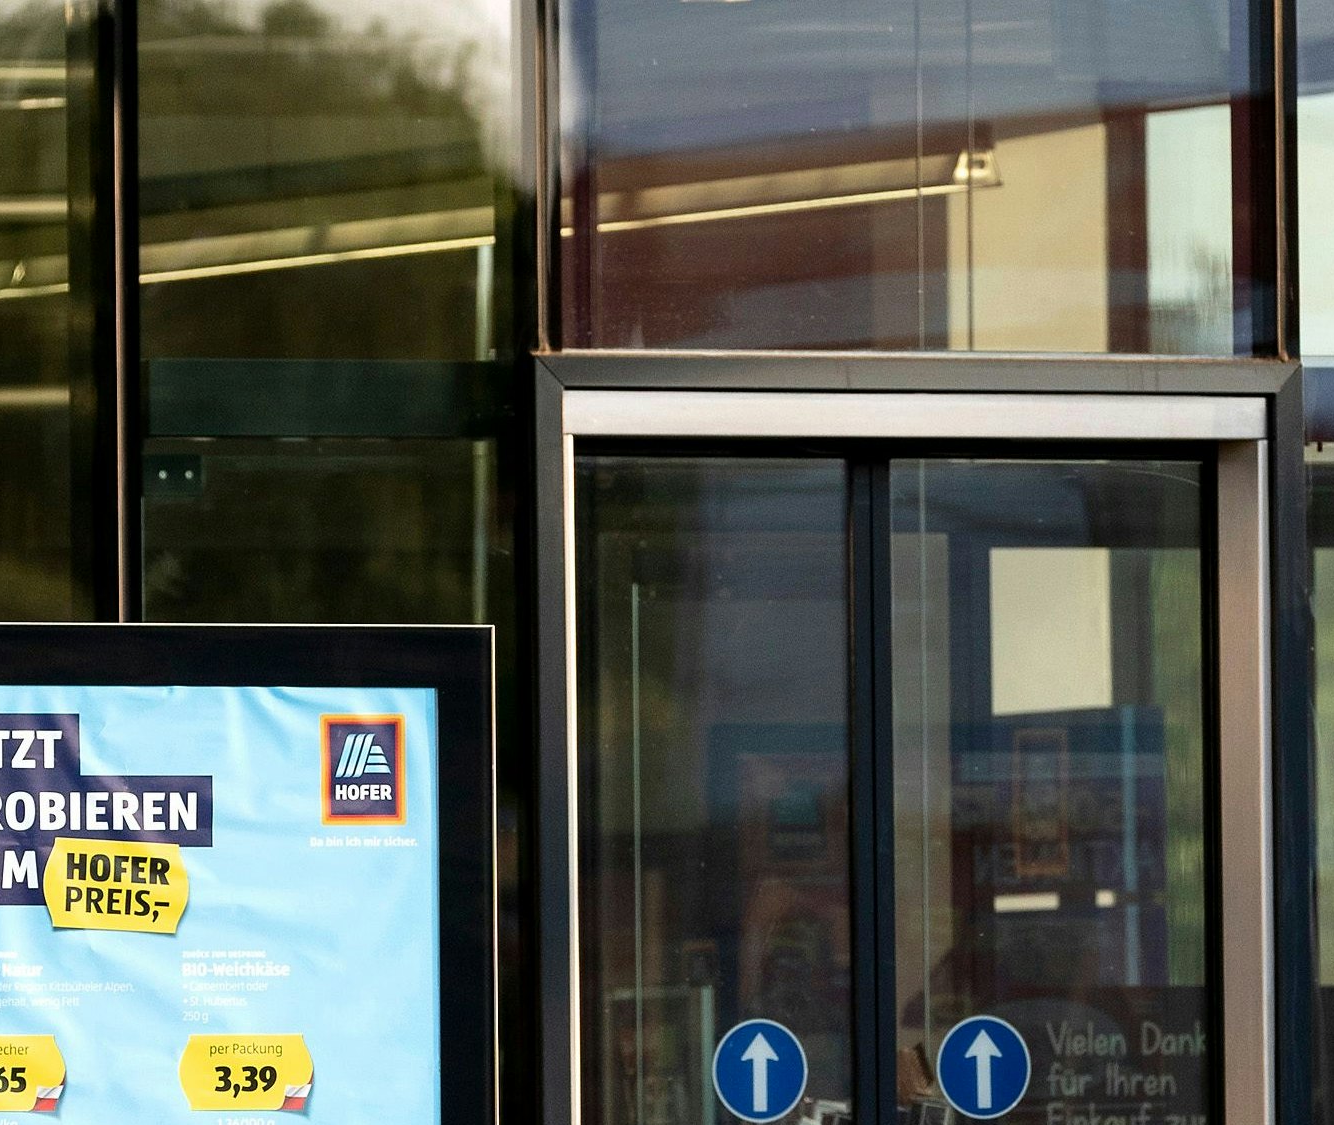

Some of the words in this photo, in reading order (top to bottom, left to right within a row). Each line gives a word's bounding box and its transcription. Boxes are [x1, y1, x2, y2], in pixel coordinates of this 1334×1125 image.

[334, 784, 392, 801] HOFER
[65, 853, 170, 886] HOFER
[182, 961, 290, 977] BIO-Weichkäse
[209, 1045, 229, 1057] per
[232, 1043, 283, 1057] Packung
[1046, 1020, 1127, 1056] Vielen
[214, 1065, 277, 1099] 3,39
[1046, 1061, 1093, 1097] für
[1105, 1062, 1177, 1096] Ihren
